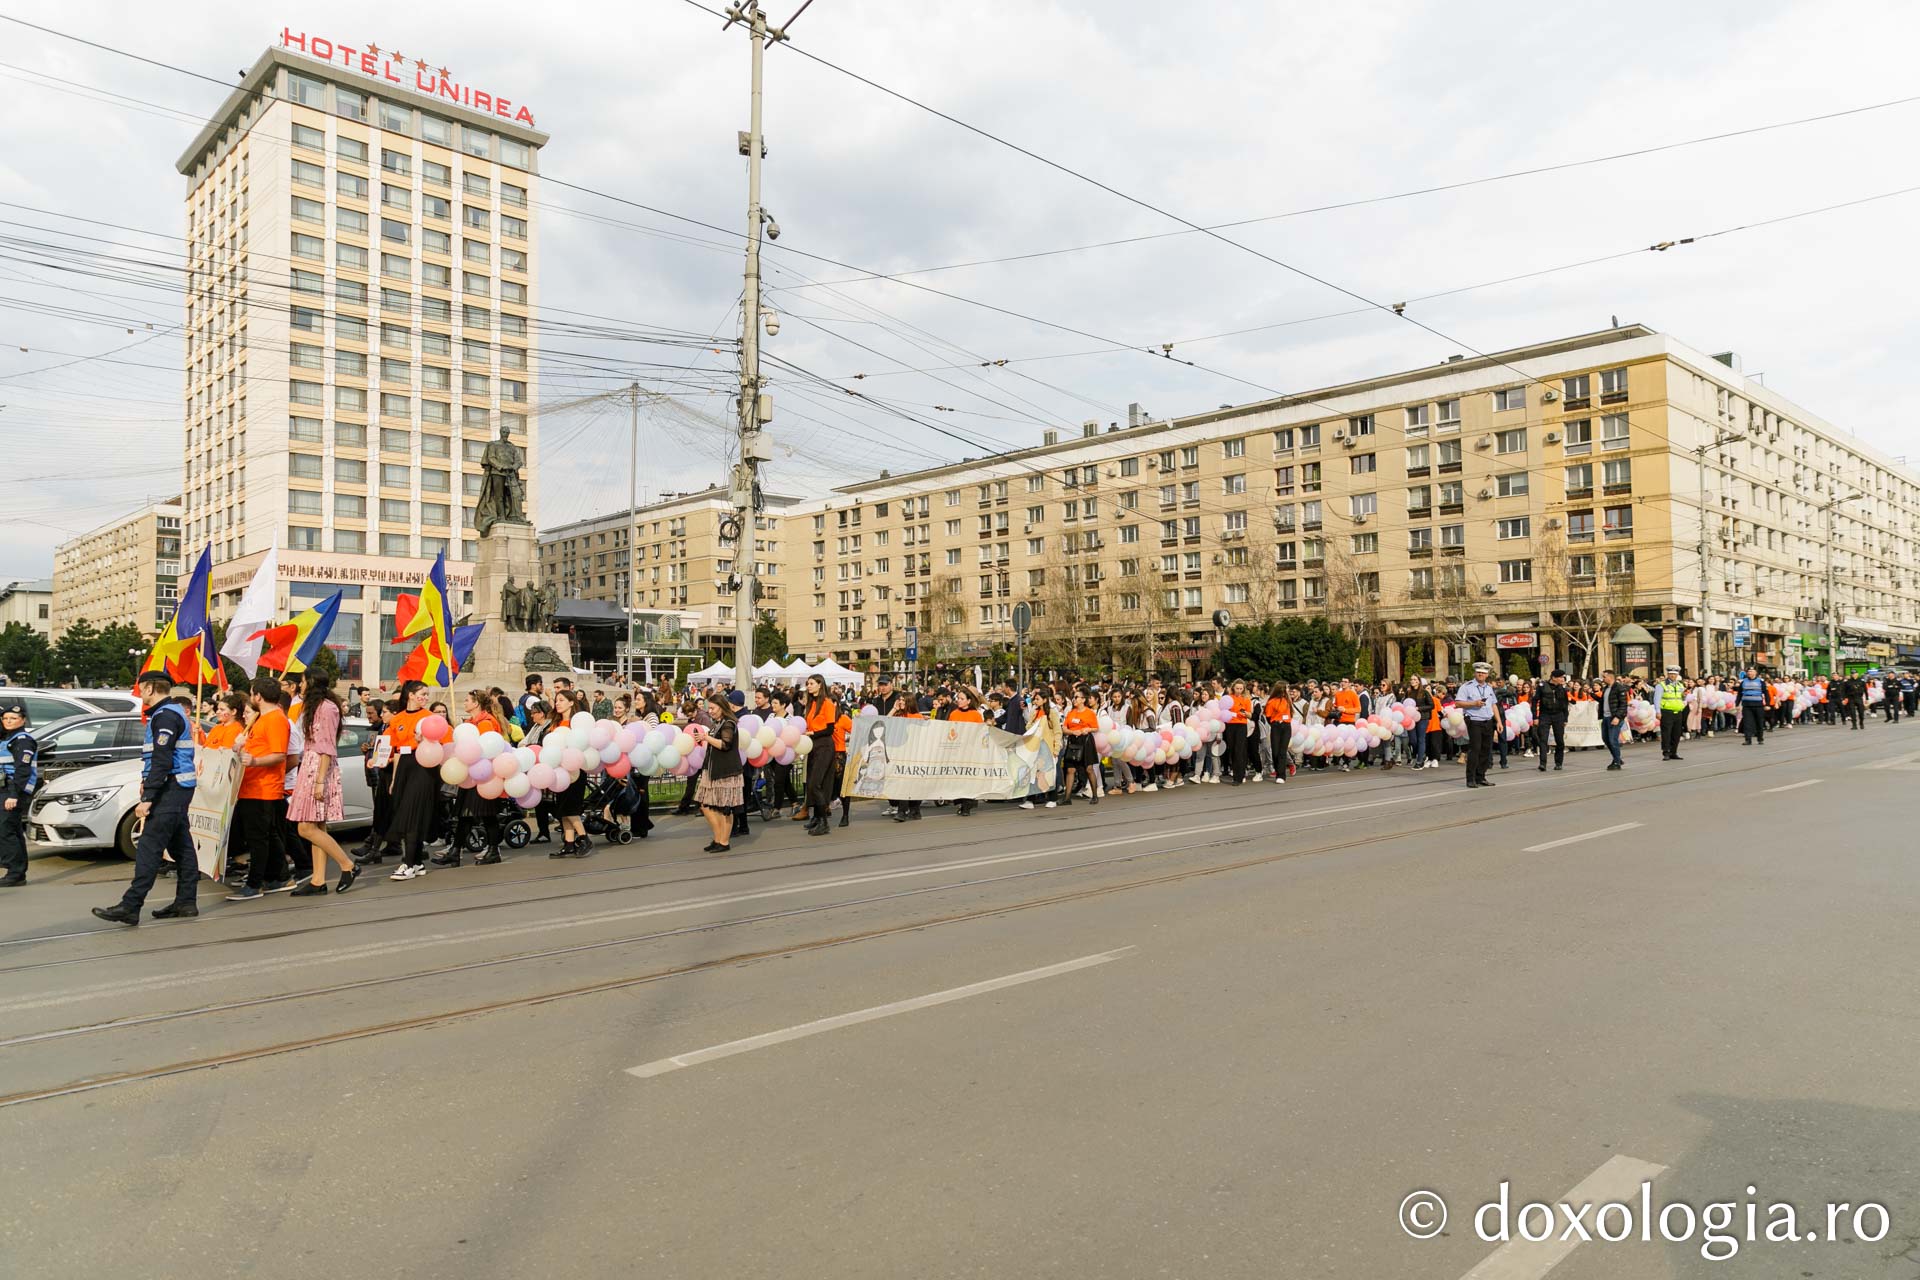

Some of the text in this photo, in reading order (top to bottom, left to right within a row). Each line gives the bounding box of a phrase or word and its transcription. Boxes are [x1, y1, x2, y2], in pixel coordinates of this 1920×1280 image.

[283, 26, 535, 127] HOTEL UNIREA
[1734, 618, 1744, 631] P
[940, 766, 980, 777] PENTRU
